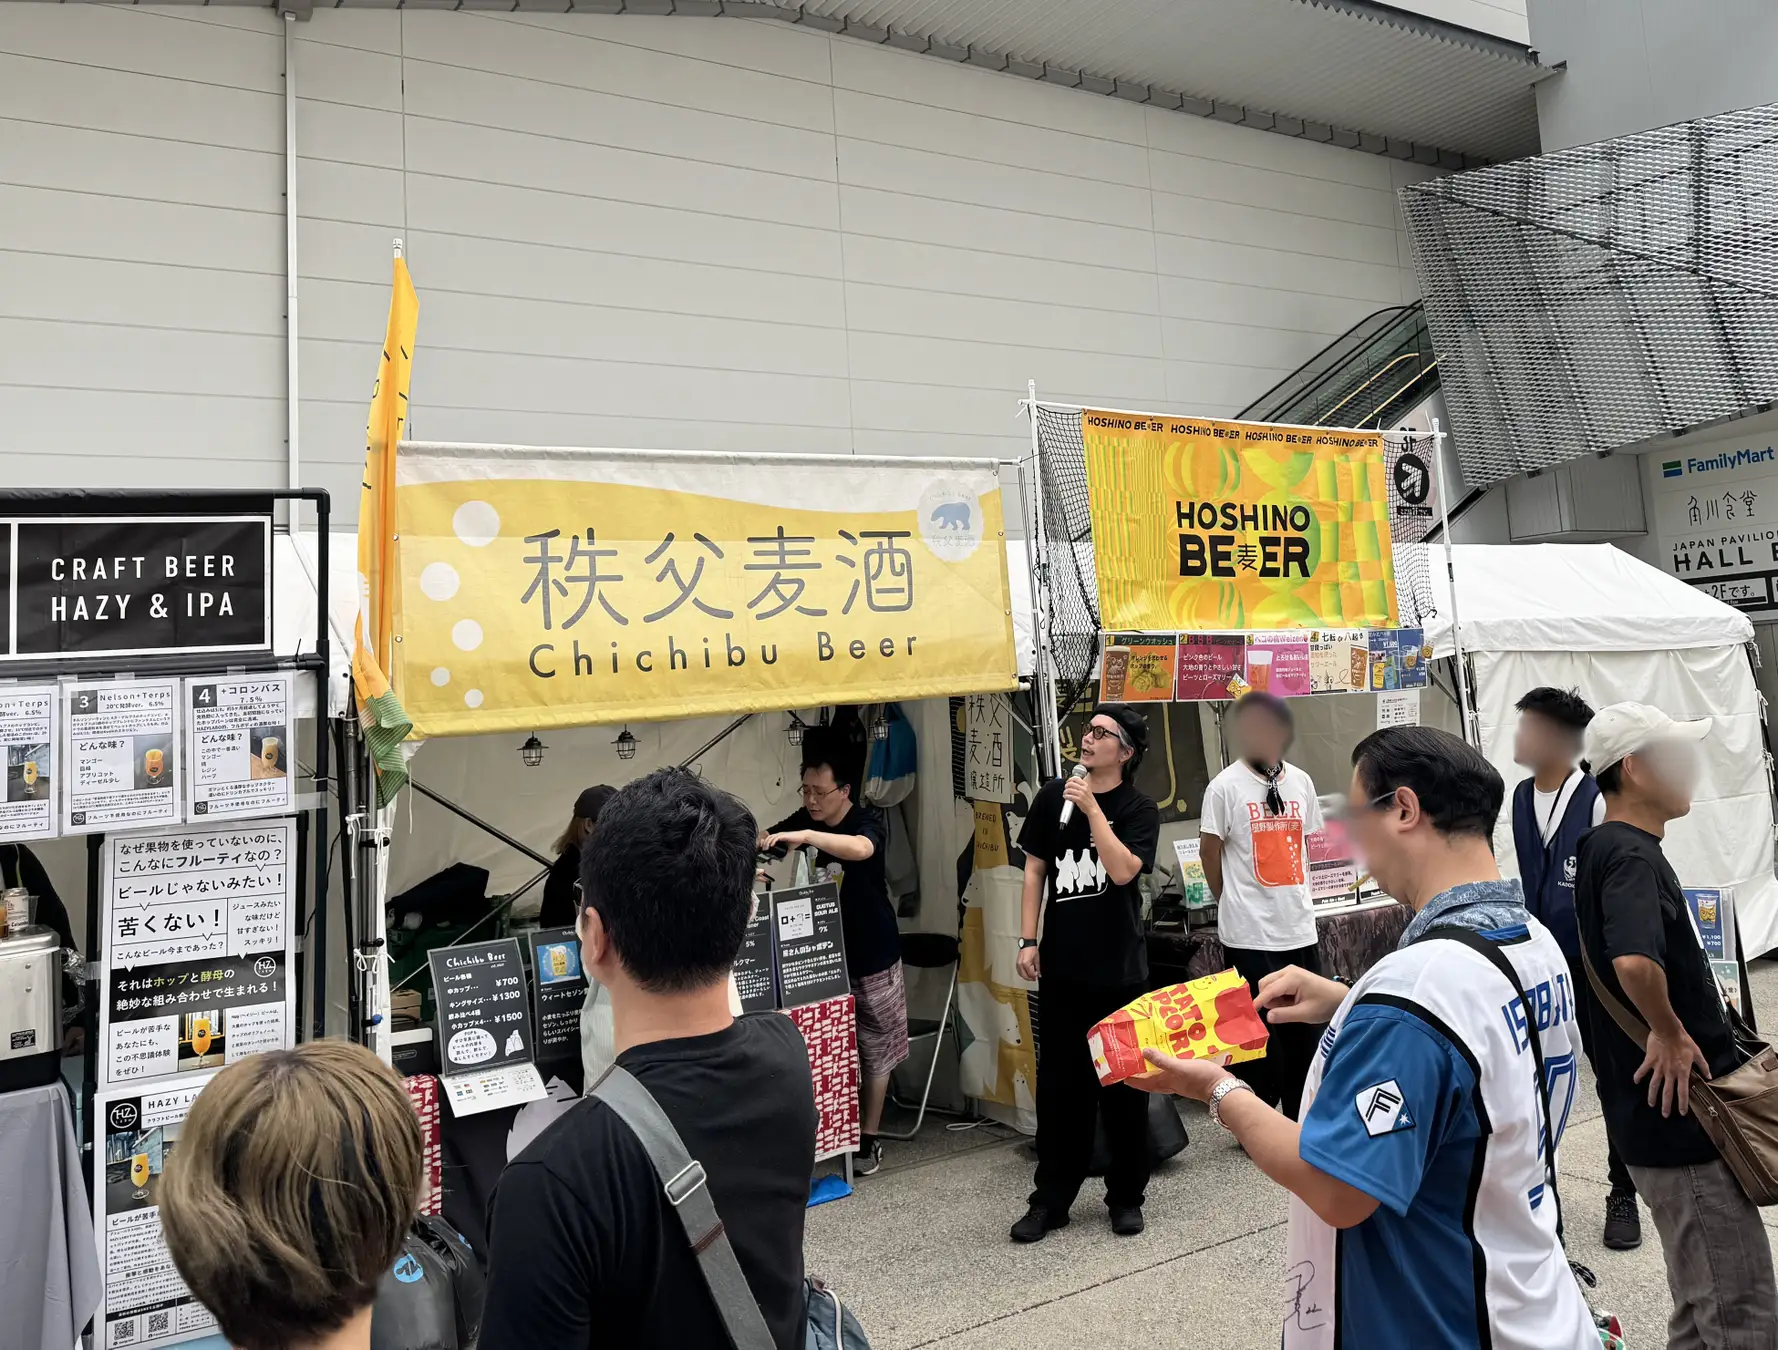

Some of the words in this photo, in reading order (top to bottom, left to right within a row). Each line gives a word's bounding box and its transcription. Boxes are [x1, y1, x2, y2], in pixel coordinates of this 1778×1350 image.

[1088, 416, 1131, 429] HOSHINO
[1171, 424, 1211, 436] HOSHINO
[1245, 431, 1283, 442] HOSHINO
[1316, 437, 1354, 447] HOSHINO
[1687, 446, 1774, 473] FamilyMart
[1175, 501, 1311, 532] HOSHINO
[1687, 490, 1758, 526] 角川食堂
[1673, 538, 1715, 551] JAPAN
[51, 556, 145, 581] CRAFT
[165, 554, 235, 578] BEER
[1673, 546, 1753, 573] HALL
[520, 525, 913, 630] 秩父麦酒
[51, 594, 131, 621] HAZY
[149, 593, 168, 618] &
[187, 591, 234, 617] IPA
[529, 633, 778, 678] Chichibu
[817, 631, 917, 662] Beer
[79, 696, 89, 708] 3
[100, 692, 170, 701] Nelson+Terps
[199, 688, 210, 703] 4
[79, 741, 125, 751] どんな味？
[968, 728, 1002, 767] 麦酒
[120, 833, 282, 855] なぜ果物を使っていないのに、
[119, 848, 282, 873] こんなにフルーティなの？
[118, 873, 282, 899] ビールじゃないみたい！
[232, 900, 281, 910] ジュースみたい
[118, 909, 219, 938] 苦くない！
[244, 911, 281, 922] な味だけど
[237, 924, 279, 935] 甘すぎない！
[244, 936, 279, 946] スッキリ！
[116, 941, 224, 960] こんなビール今まであった？
[117, 969, 235, 992] それはホップと酵母の
[495, 976, 519, 987] ¥700
[116, 981, 277, 1011] 絶妙な組み合わせで生まれる！
[492, 991, 520, 1002] ¥1300
[494, 1011, 523, 1024] ¥1500
[116, 1023, 171, 1037] ビールが苦手な
[116, 1039, 159, 1050] あなたにも、
[116, 1048, 171, 1063] この不思議体験
[115, 1065, 145, 1076] をぜひ！
[148, 1096, 179, 1110] HAZY
[111, 1210, 160, 1226] ビールが苦手
